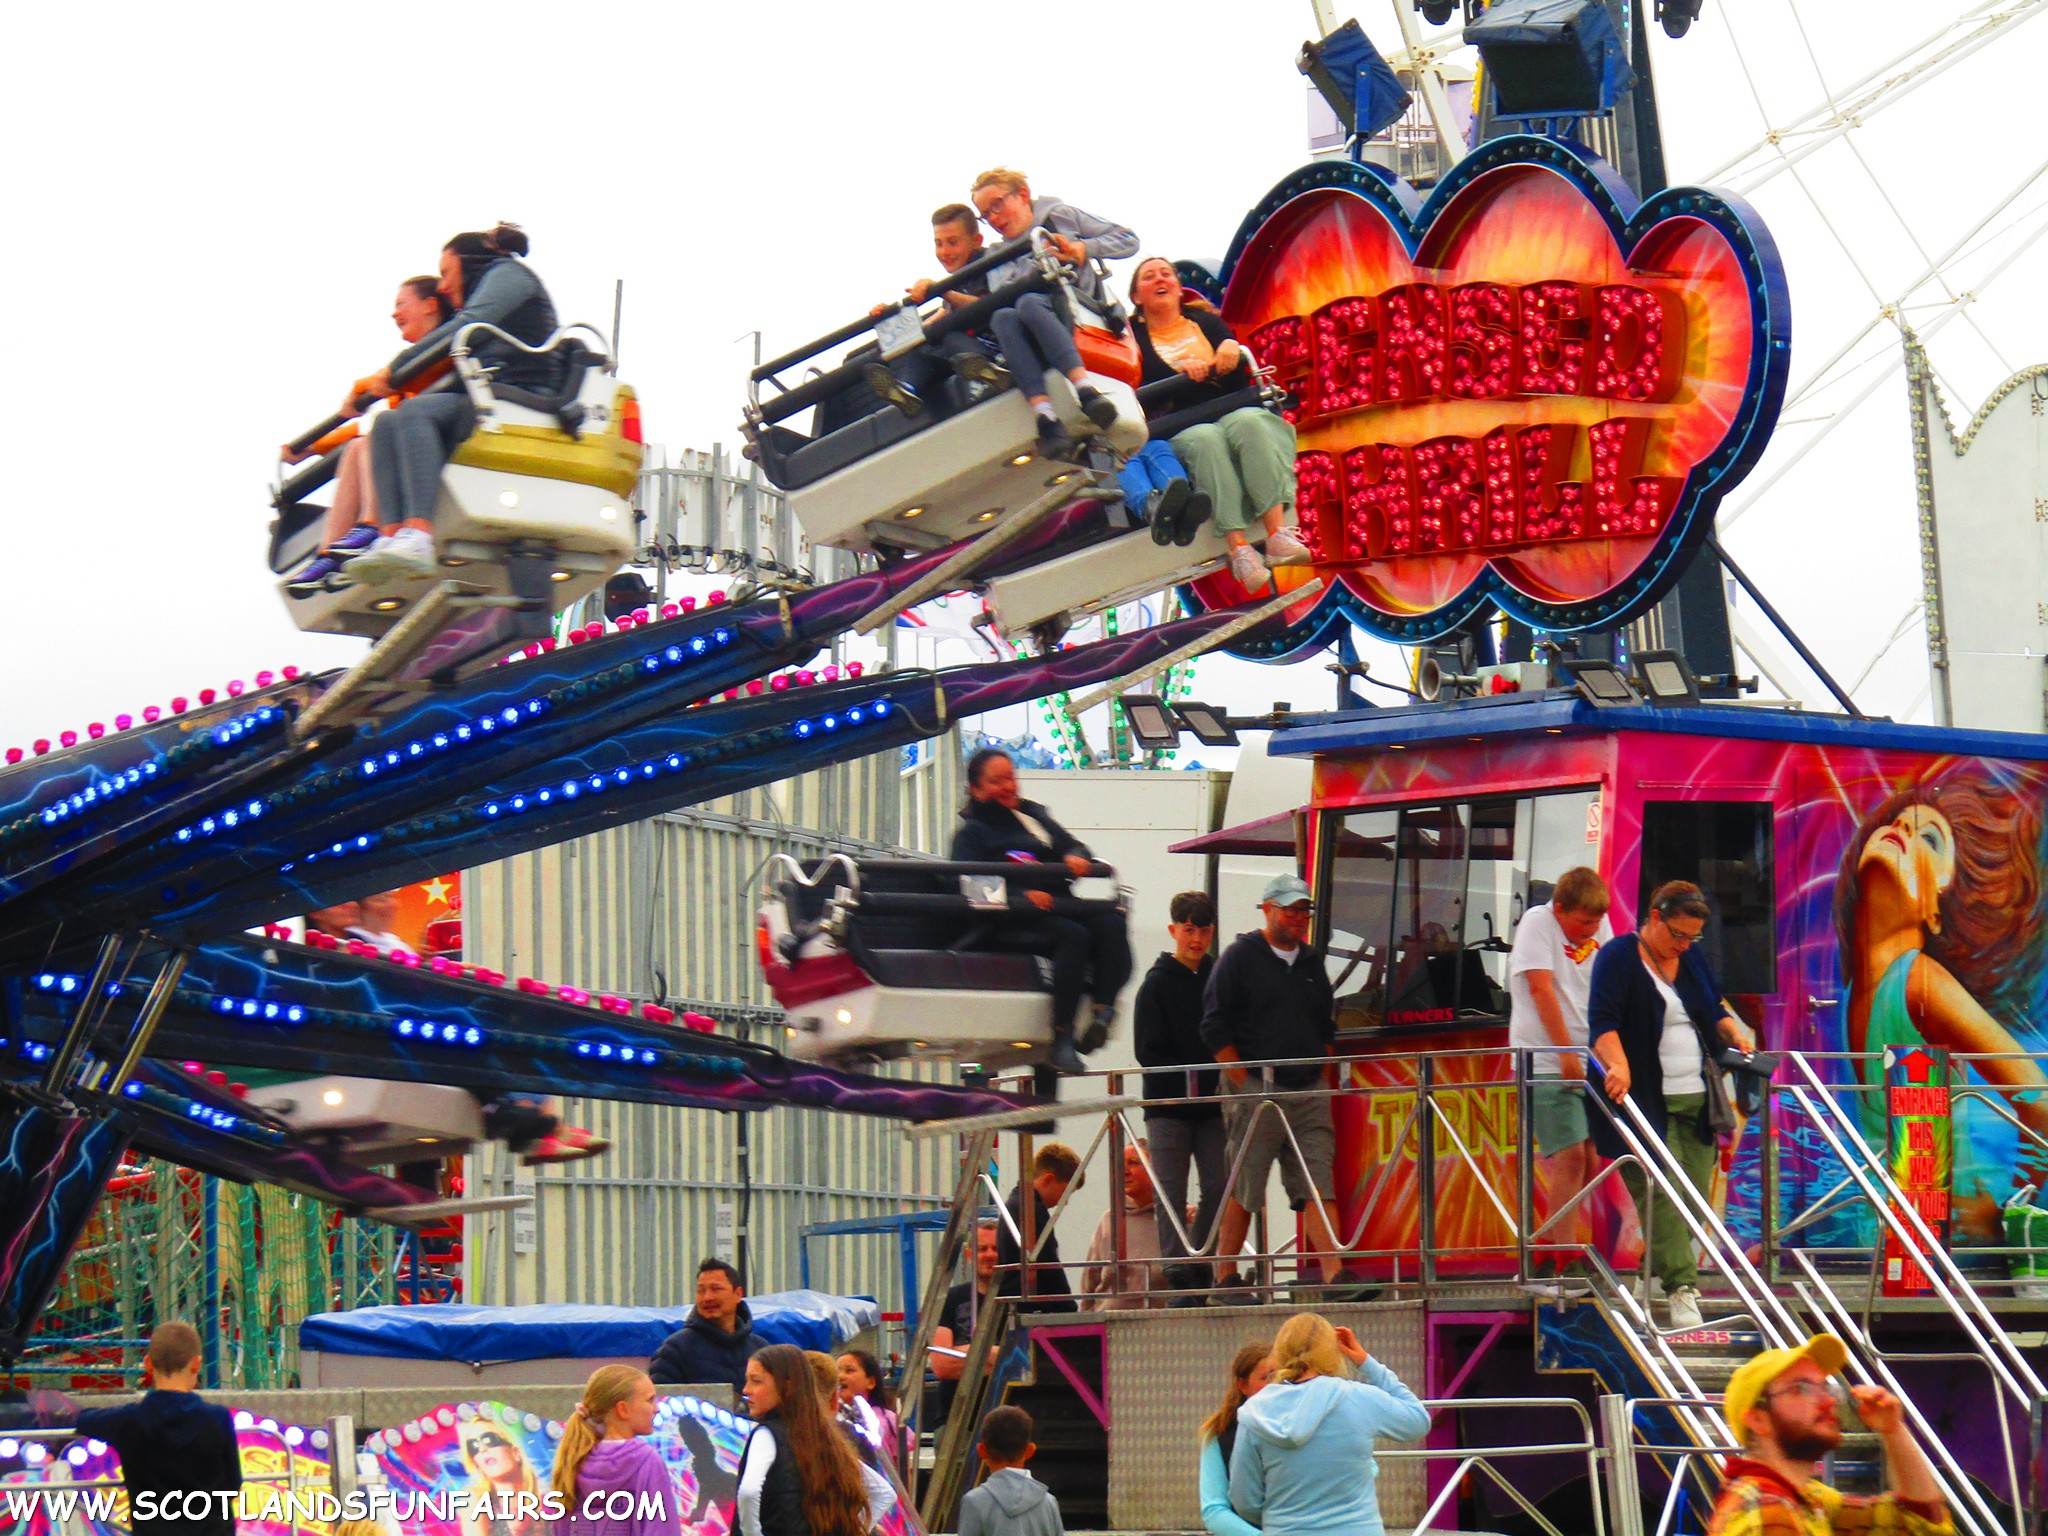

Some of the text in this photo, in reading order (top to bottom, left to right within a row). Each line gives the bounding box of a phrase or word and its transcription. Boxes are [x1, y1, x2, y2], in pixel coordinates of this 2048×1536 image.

[1387, 1007, 1454, 1025] TURNERS
[1890, 1086, 1949, 1116] ENTRANCE
[1370, 1086, 1540, 1164] TURNE
[1907, 1121, 1934, 1150] THIS
[1909, 1155, 1936, 1185] WAY
